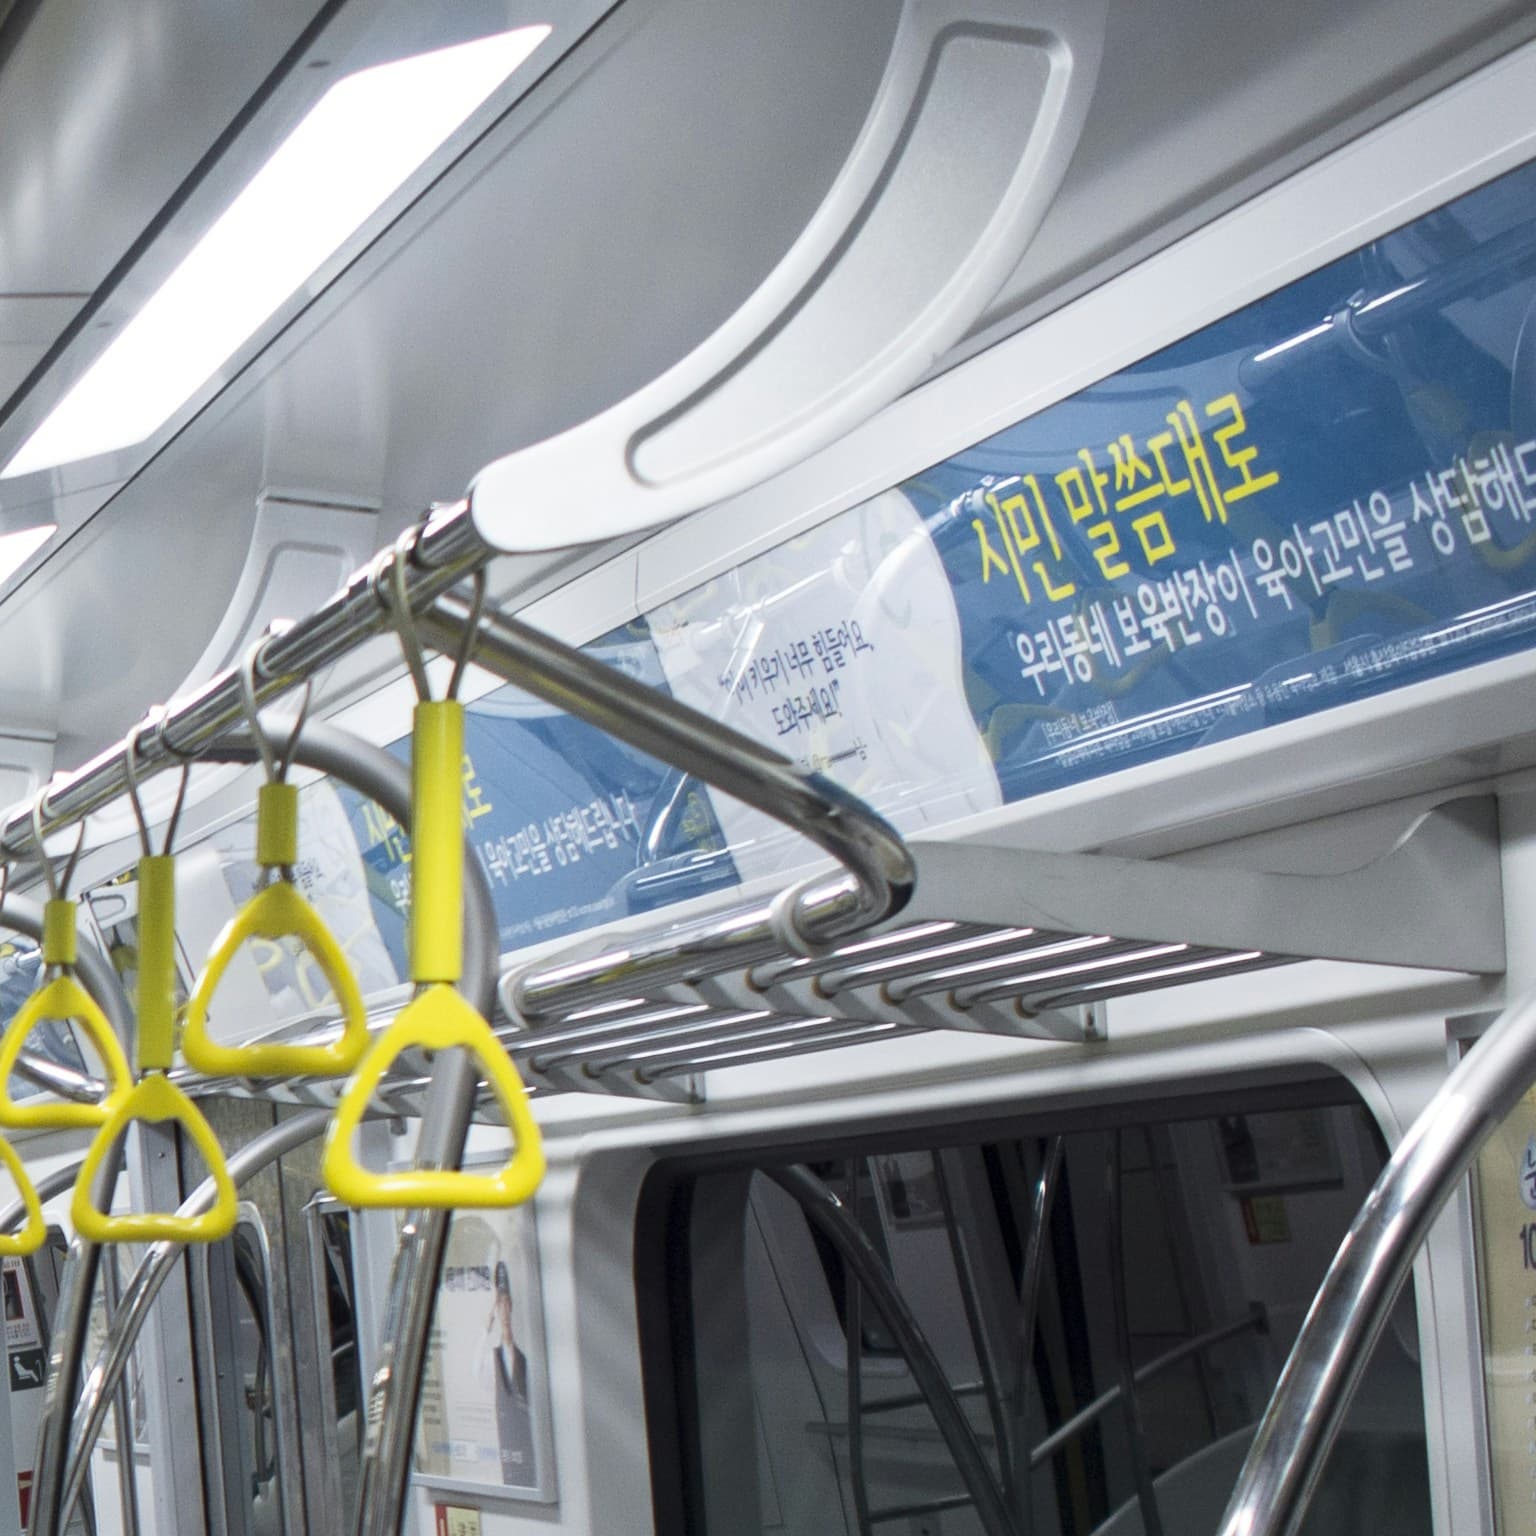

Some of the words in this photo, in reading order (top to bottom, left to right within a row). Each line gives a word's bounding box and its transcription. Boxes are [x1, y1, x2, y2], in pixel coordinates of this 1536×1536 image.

[972, 474, 1077, 604] 시민
[1054, 393, 1280, 582] 말씀대로
[1255, 490, 1414, 611] 육아고민을
[748, 648, 791, 696] 키우기
[784, 641, 815, 680] 너무
[484, 823, 555, 888] 육아고민을
